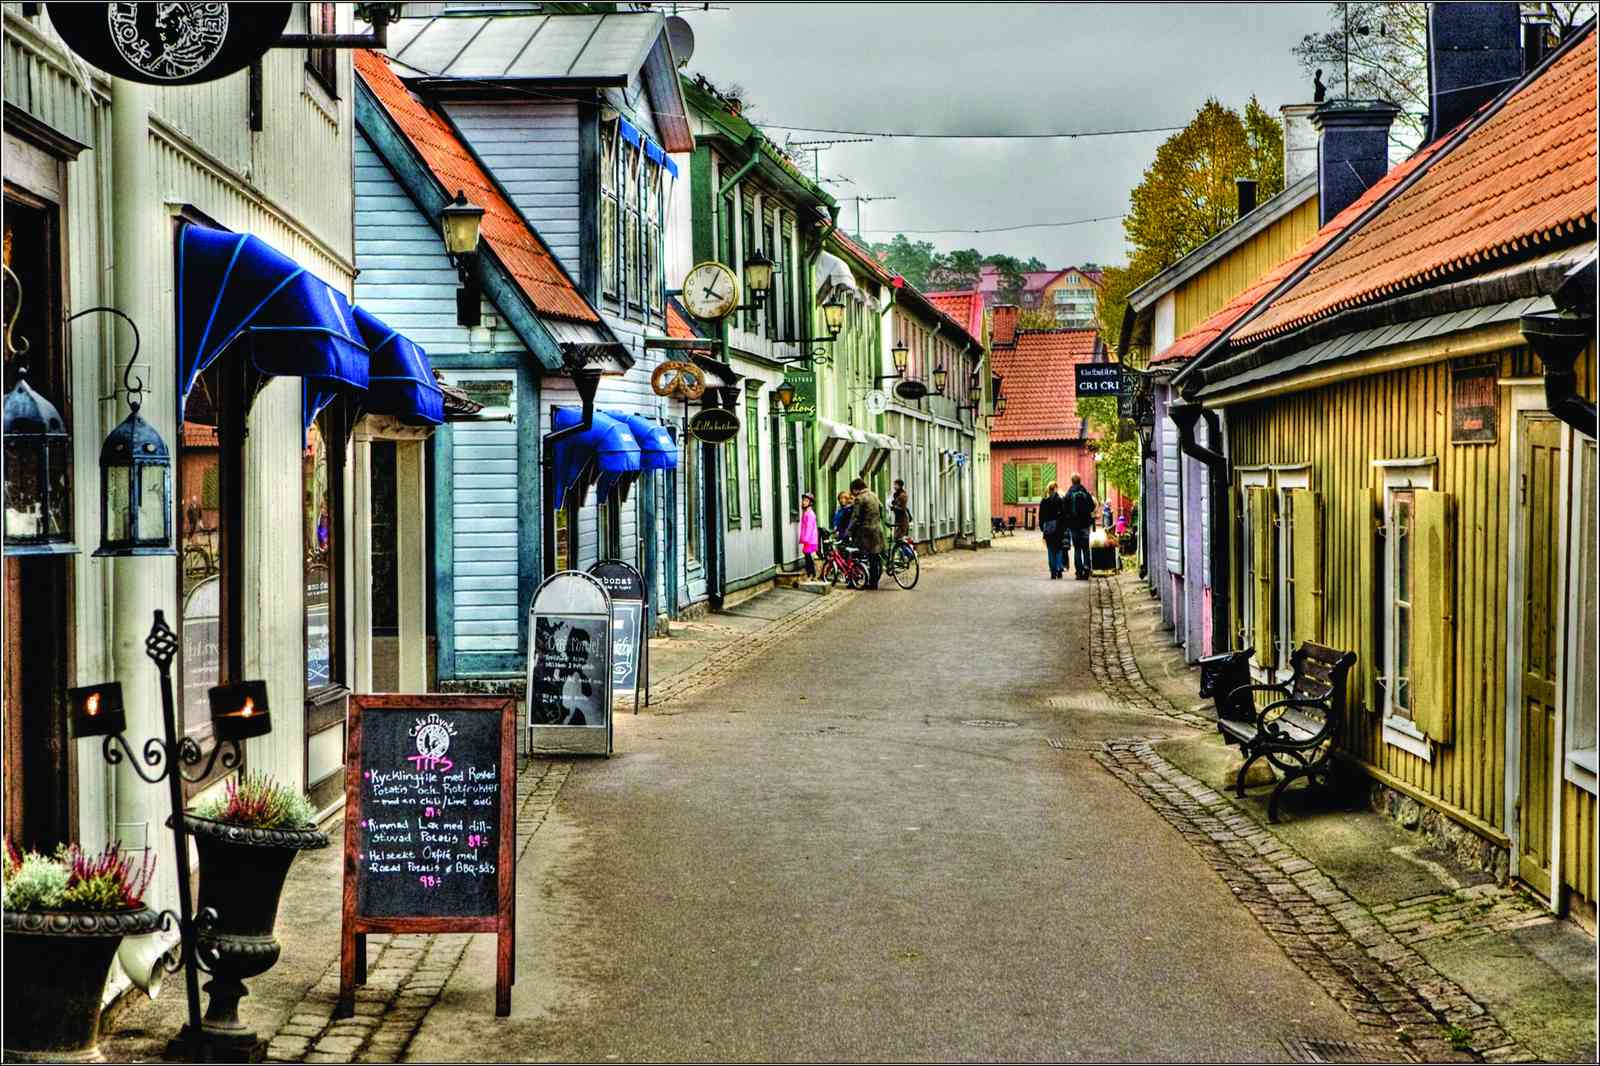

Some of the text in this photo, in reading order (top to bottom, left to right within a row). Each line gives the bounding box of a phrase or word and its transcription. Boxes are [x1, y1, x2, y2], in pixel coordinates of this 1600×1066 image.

[1080, 381, 1098, 390] CRI
[1100, 381, 1119, 390] CRI
[407, 754, 454, 771] TIPS
[443, 771, 464, 782] med
[443, 820, 464, 831] med
[456, 849, 478, 861] med
